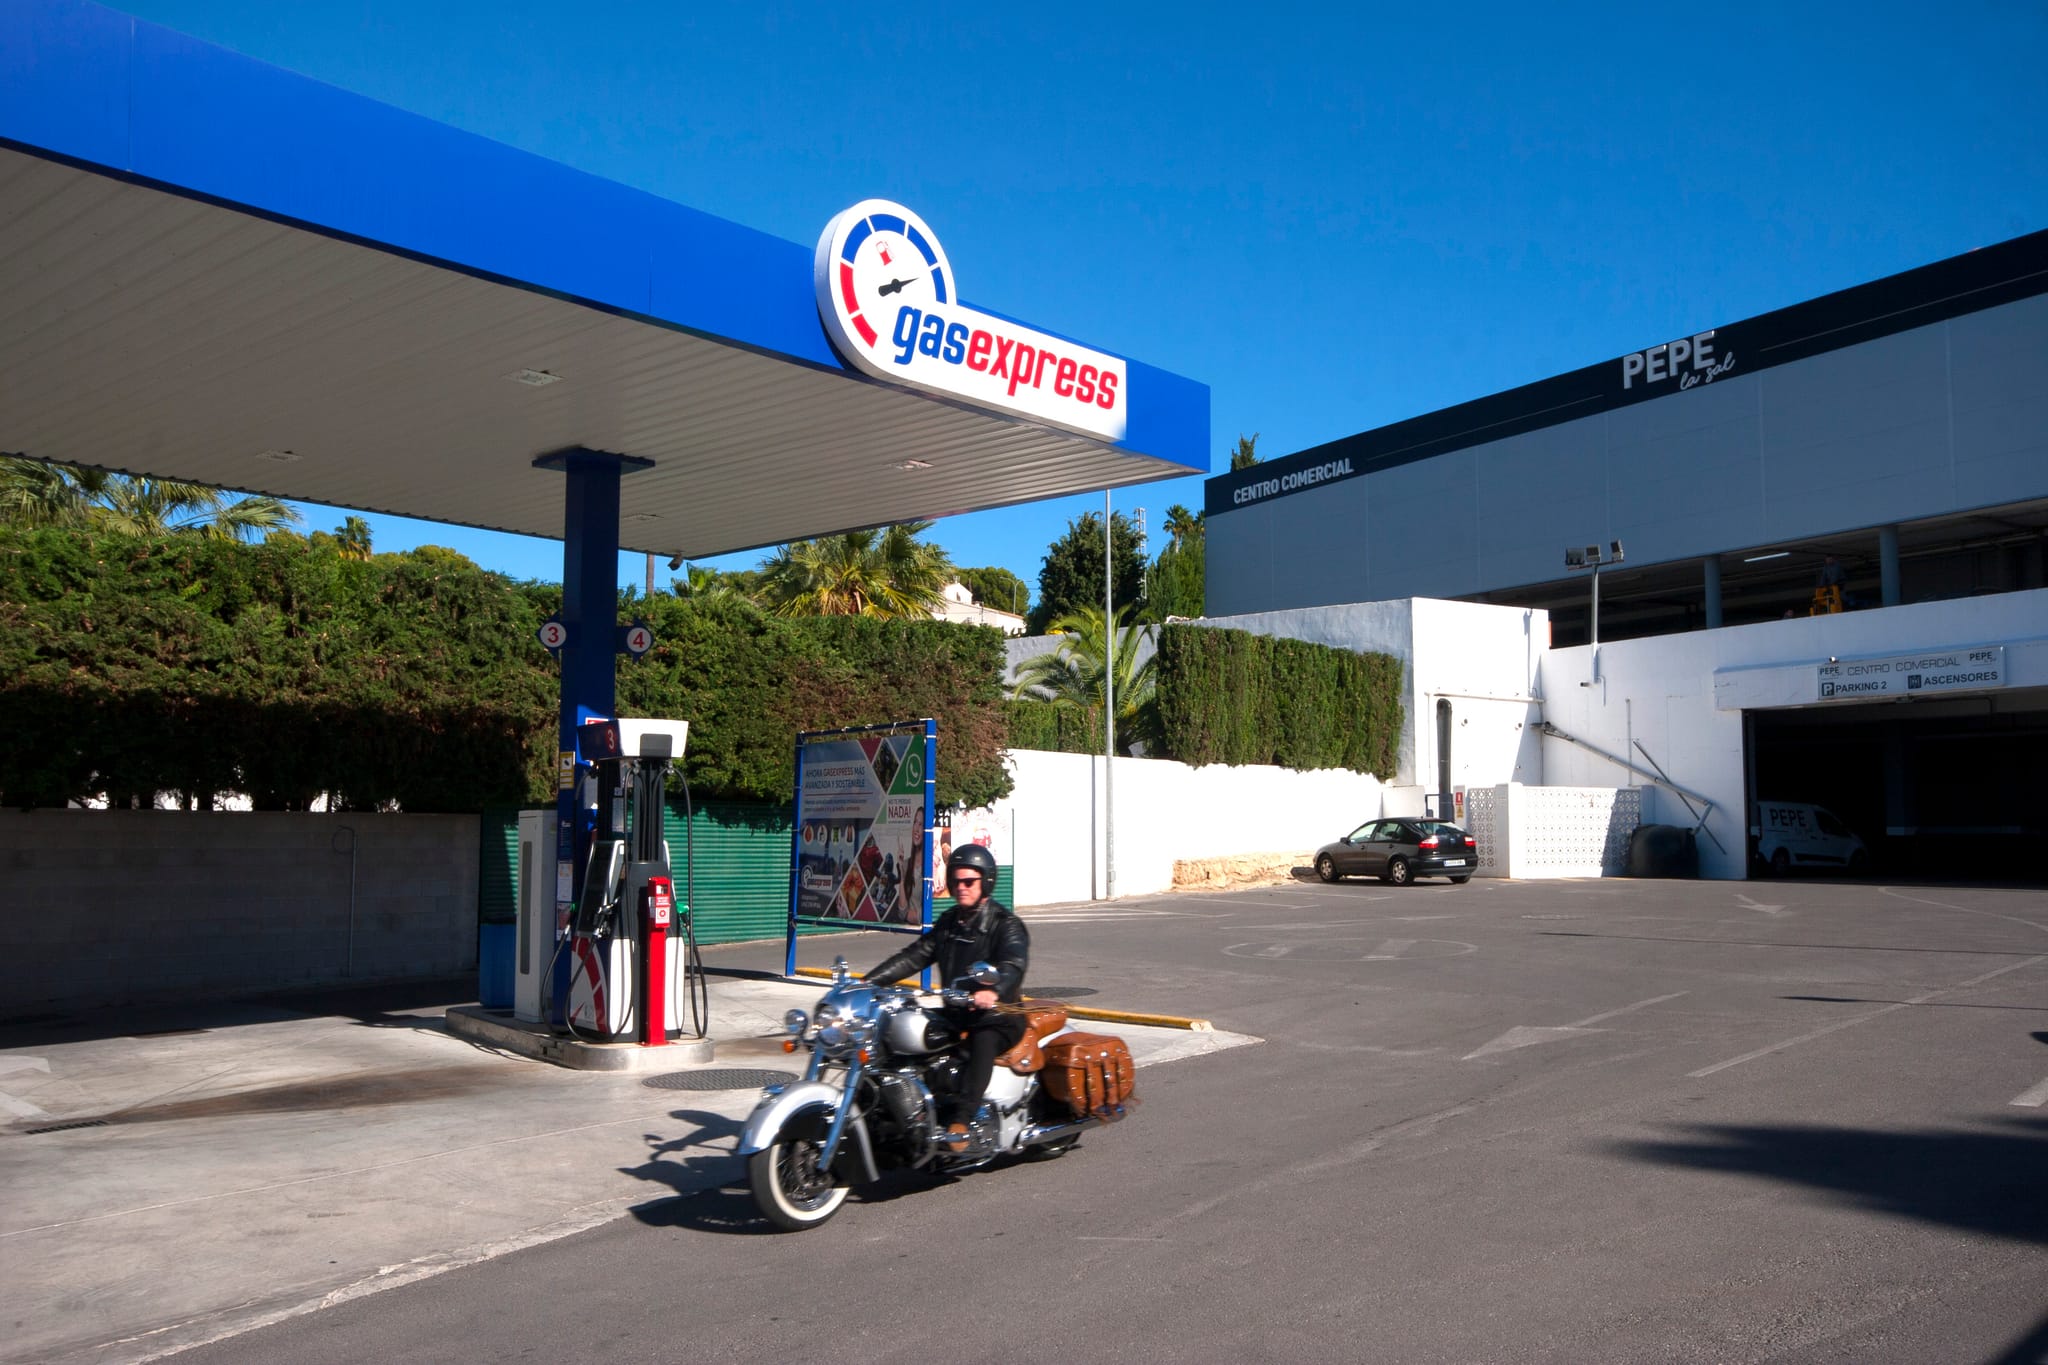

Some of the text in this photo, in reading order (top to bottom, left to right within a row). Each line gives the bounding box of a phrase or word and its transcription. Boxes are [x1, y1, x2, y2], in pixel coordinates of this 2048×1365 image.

[892, 305, 1119, 411] gasexpress
[1623, 330, 1716, 389] PEPE
[1680, 351, 1736, 390] la sal
[1233, 458, 1354, 504] CENTRO COMERCIAL
[548, 626, 559, 643] 3
[632, 631, 645, 648] 4
[1969, 651, 1992, 662] PEPE
[1819, 666, 1840, 676] PEPE
[1847, 657, 1960, 676] CENTRO COMERCIAL
[1835, 681, 1879, 693] PARKING
[1881, 680, 1887, 690] 2
[1923, 671, 1998, 686] ASCENSORES
[607, 728, 616, 750] 3
[888, 805, 911, 818] NADA!
[1769, 808, 1807, 827] PEPE
